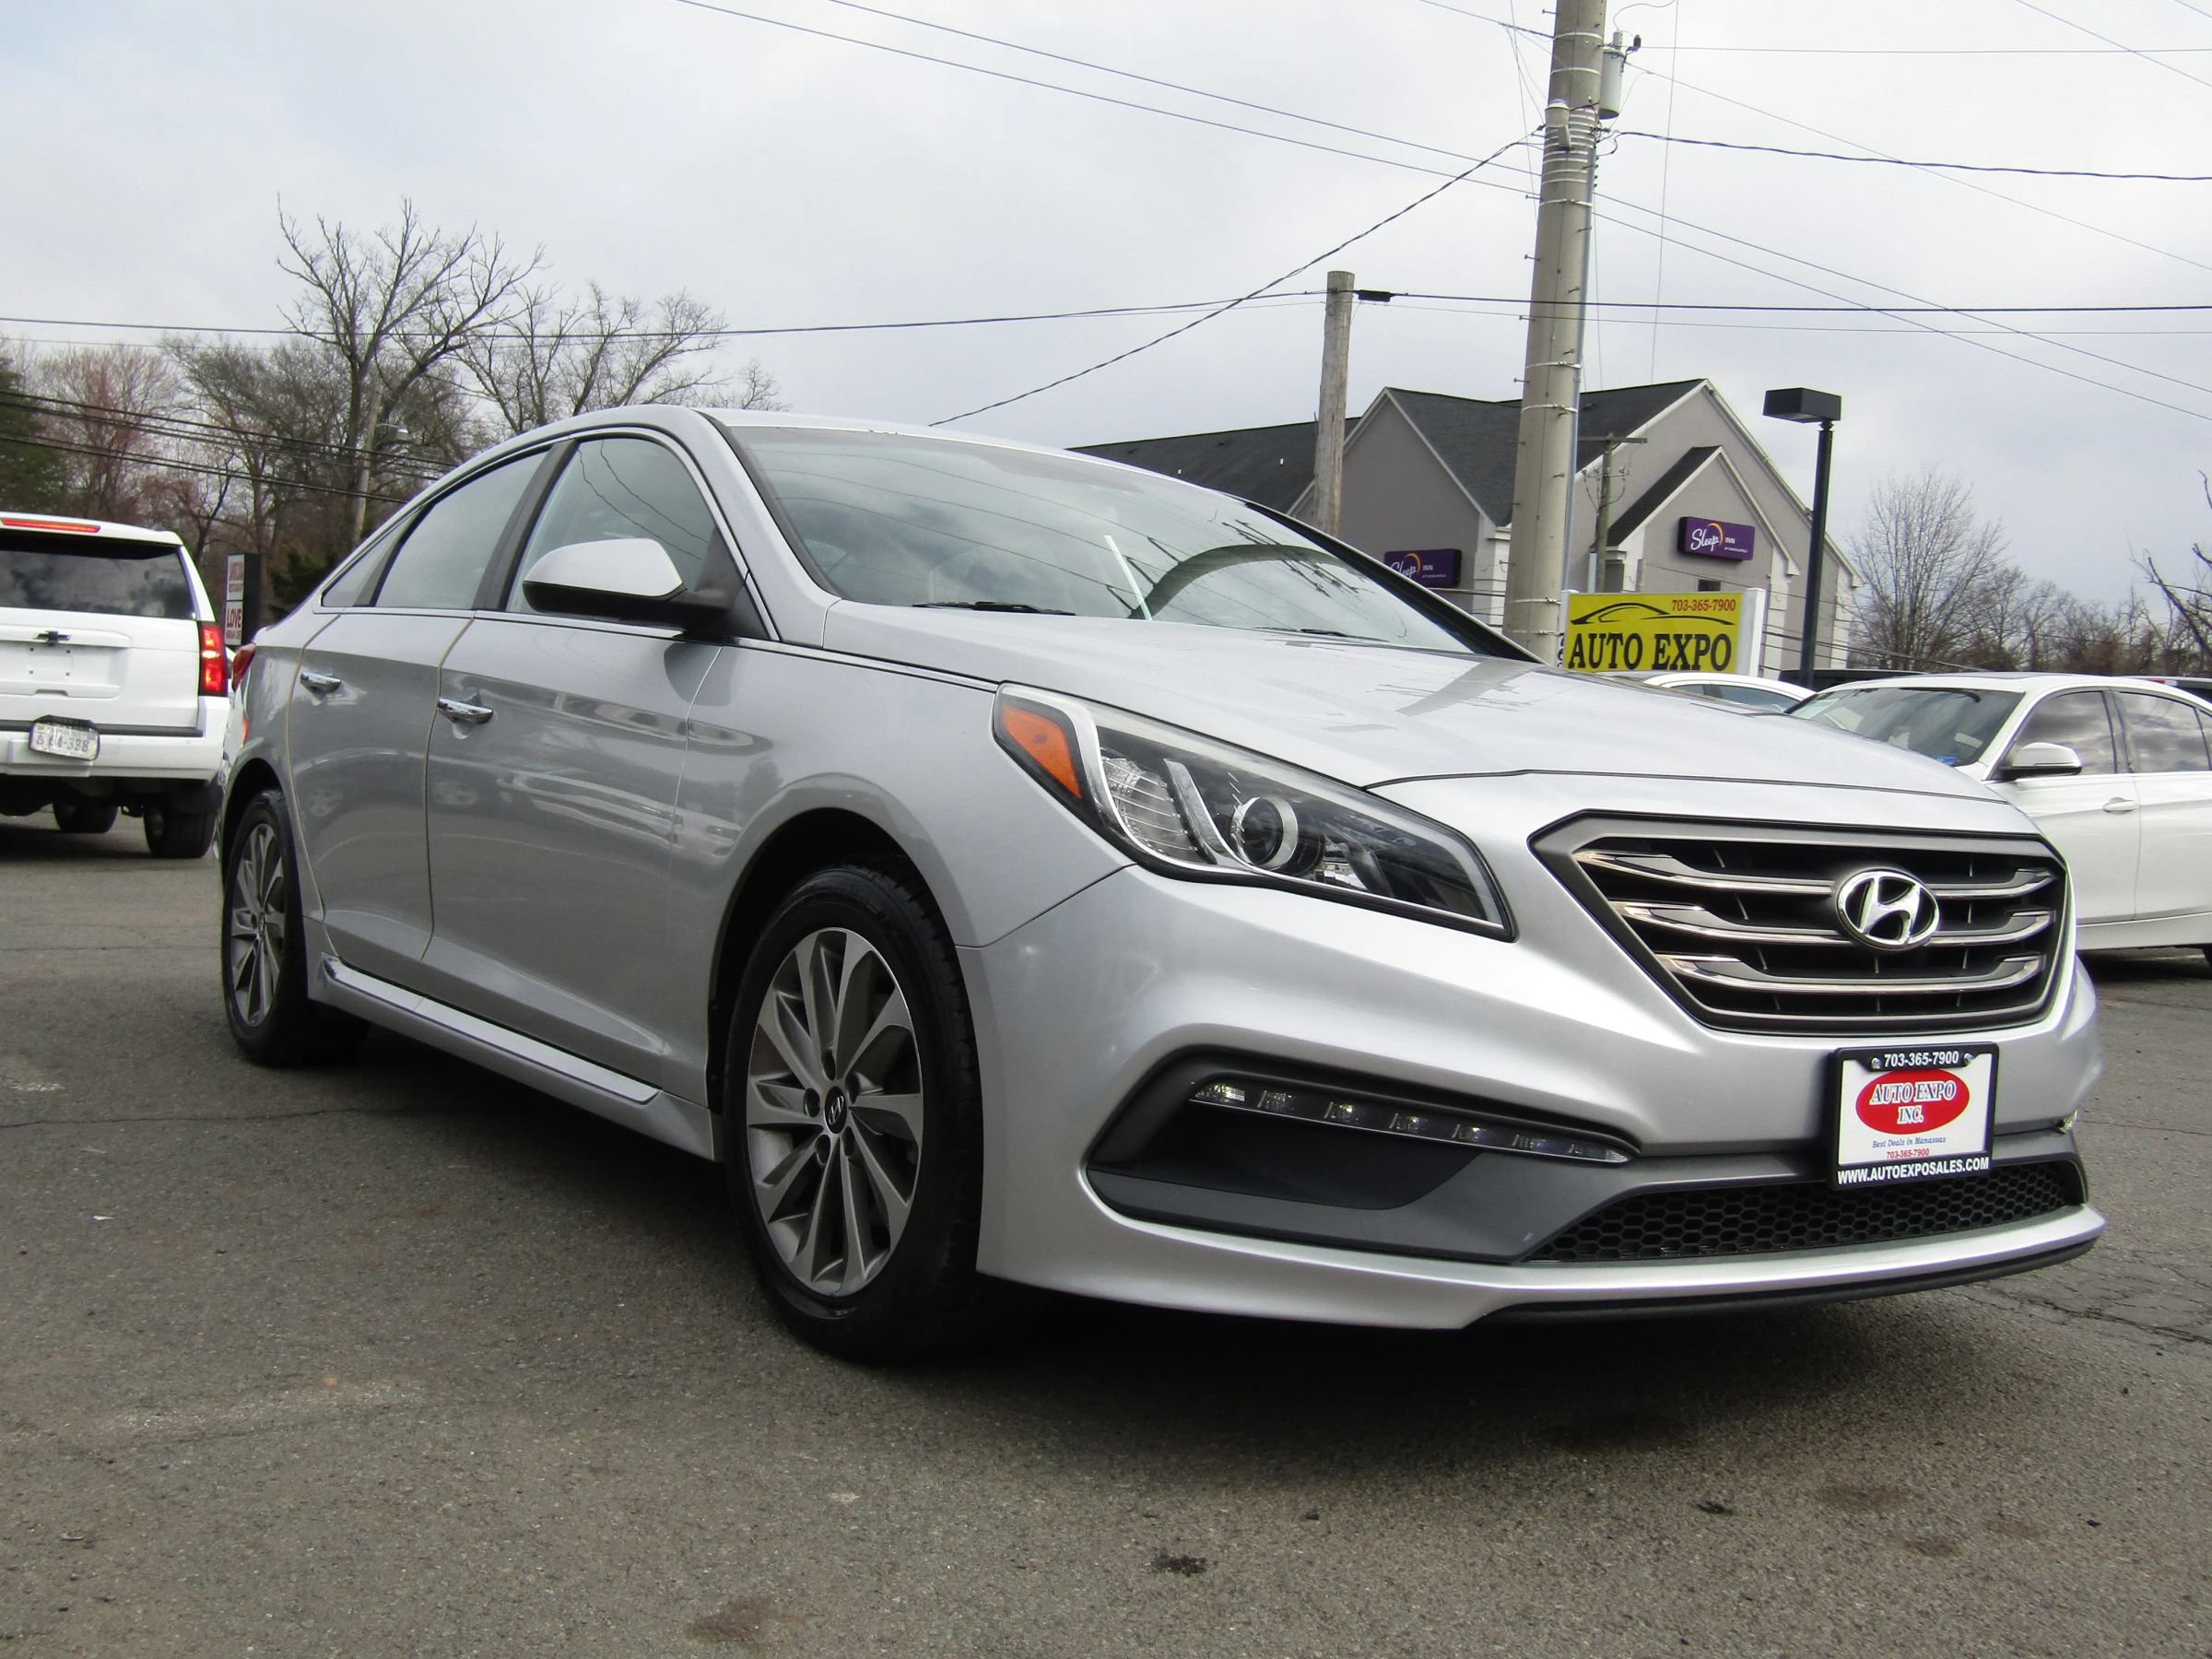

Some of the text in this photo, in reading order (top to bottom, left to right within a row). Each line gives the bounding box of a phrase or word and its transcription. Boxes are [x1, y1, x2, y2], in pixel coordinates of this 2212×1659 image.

[1690, 528, 1720, 552] Sleep
[1671, 599, 1736, 612] 703-365-7900
[227, 608, 241, 629] LOVE
[1568, 632, 1732, 671] AUTO EXPO
[1884, 1051, 1959, 1067] 703-365-7900
[1869, 1080, 1957, 1105] AUTO EXPO
[1897, 1106, 1924, 1124] INC.
[1872, 1140, 1887, 1148] Best
[1888, 1139, 1906, 1147] Deals
[1914, 1135, 1947, 1145] Manassas
[1887, 1148, 1930, 1159] 703-365-7900
[1837, 1157, 1990, 1185] WWW.AUTOEXPOSALES.COM
